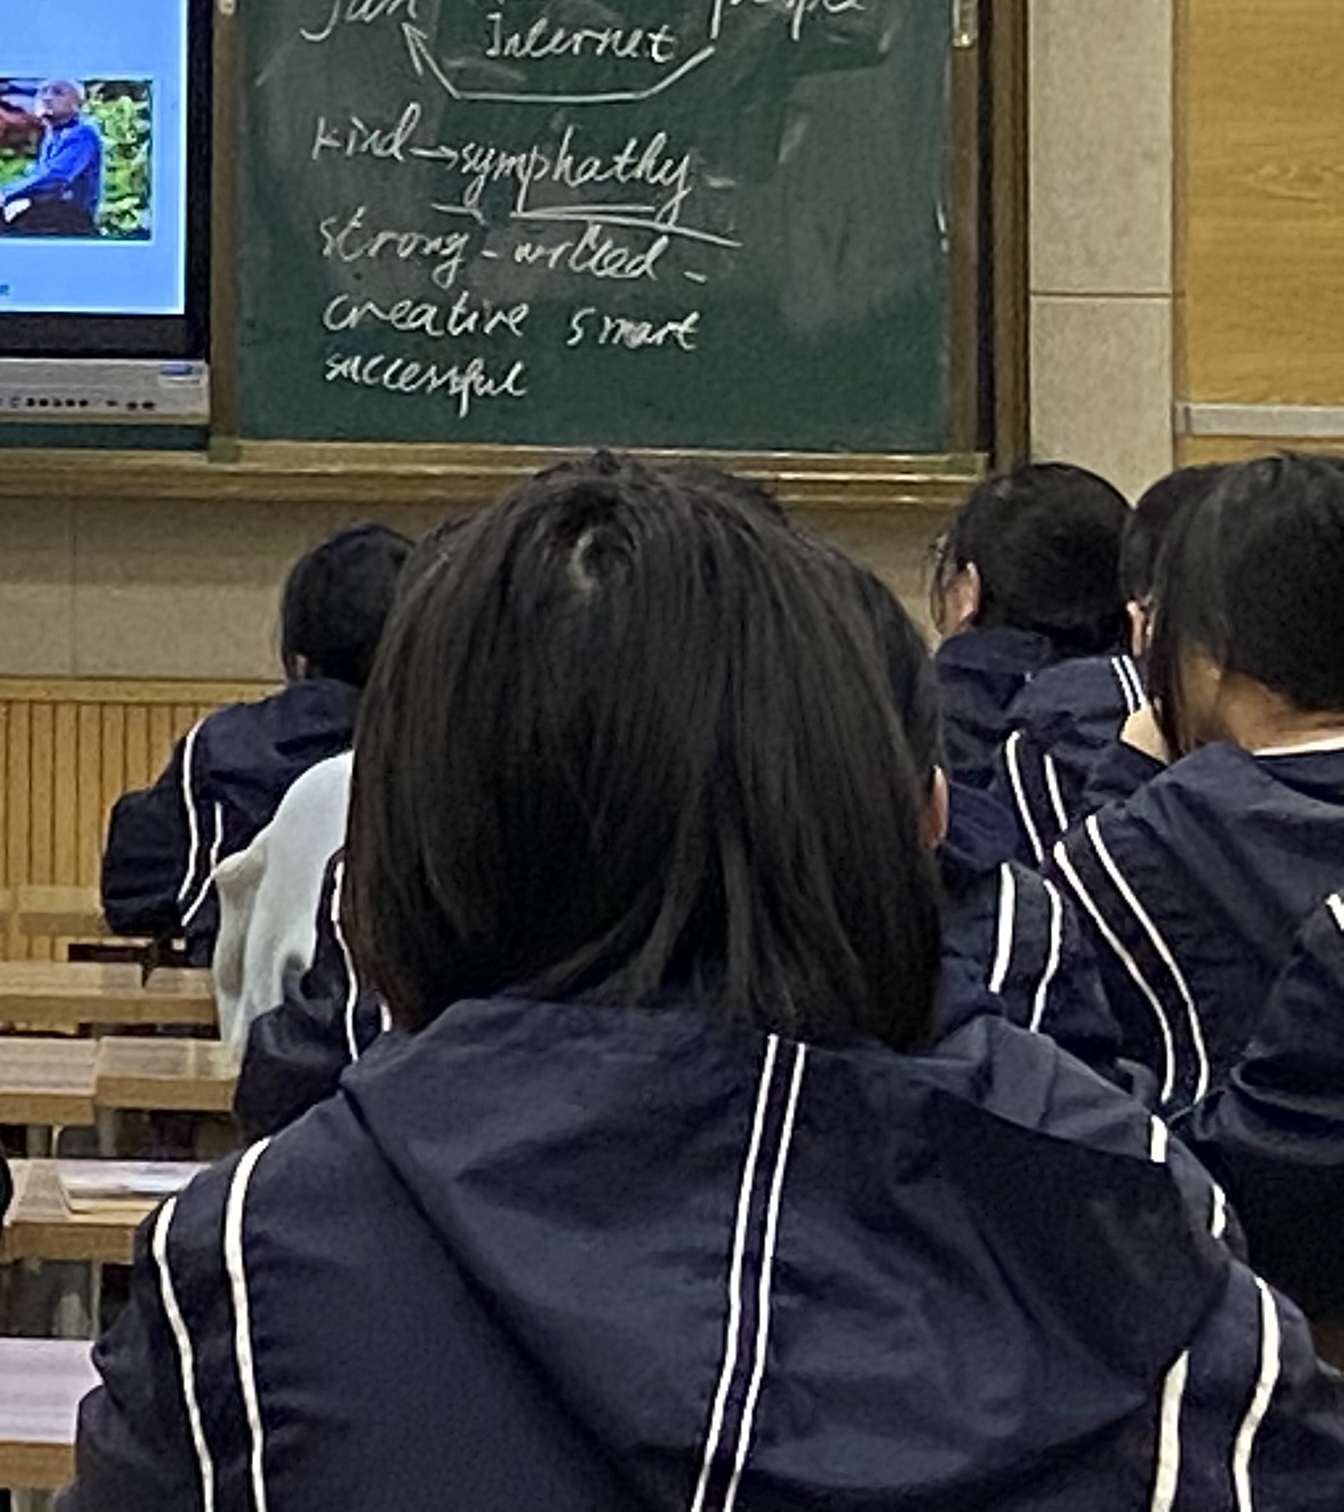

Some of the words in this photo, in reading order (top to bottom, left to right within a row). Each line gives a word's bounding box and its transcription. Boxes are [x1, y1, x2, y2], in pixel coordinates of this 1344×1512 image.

[484, 11, 677, 64] Internet
[311, 101, 421, 162] kind
[322, 291, 530, 337] creative
[566, 306, 701, 350] smart
[324, 349, 528, 418] successful
